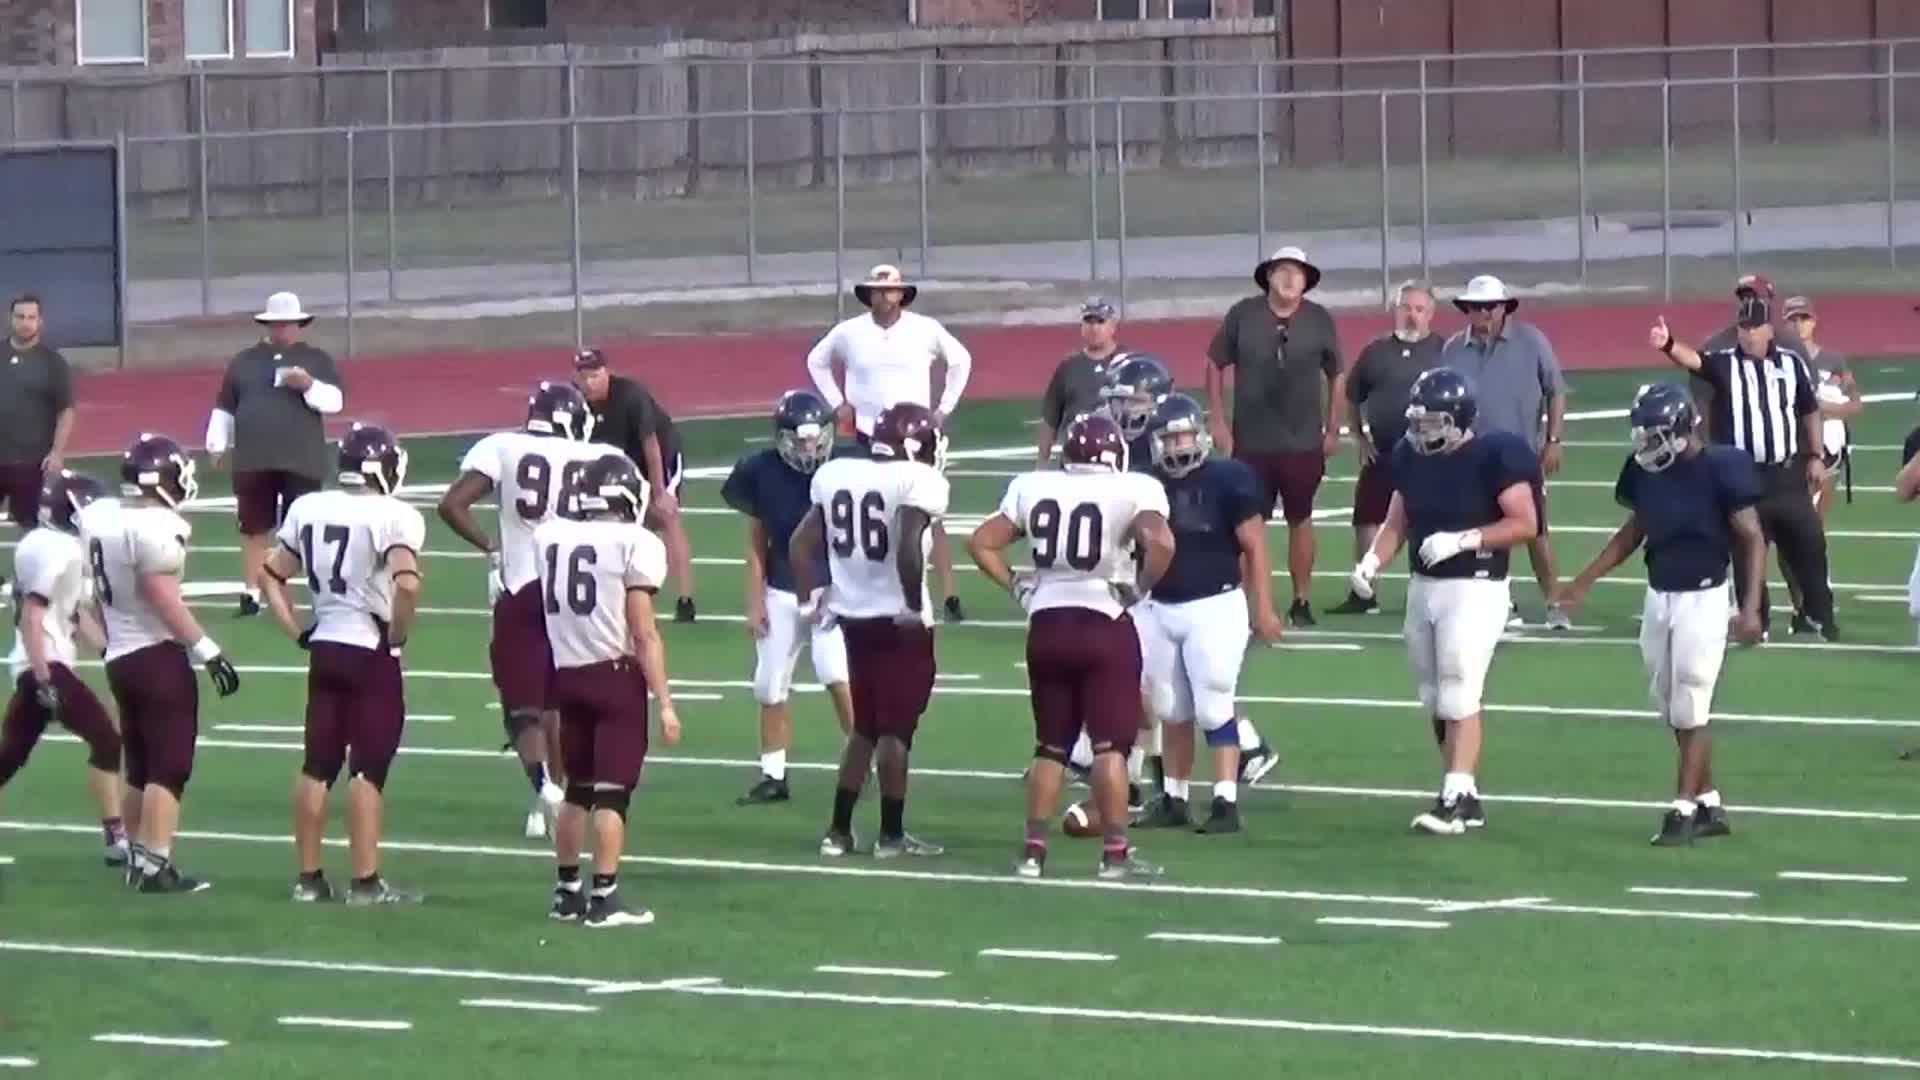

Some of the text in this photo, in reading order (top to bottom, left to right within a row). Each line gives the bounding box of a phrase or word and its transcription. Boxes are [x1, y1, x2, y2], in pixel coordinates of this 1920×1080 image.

[300, 523, 351, 595] 17
[831, 489, 889, 561] 96
[1030, 498, 1103, 571] 90
[546, 543, 597, 615] 16
